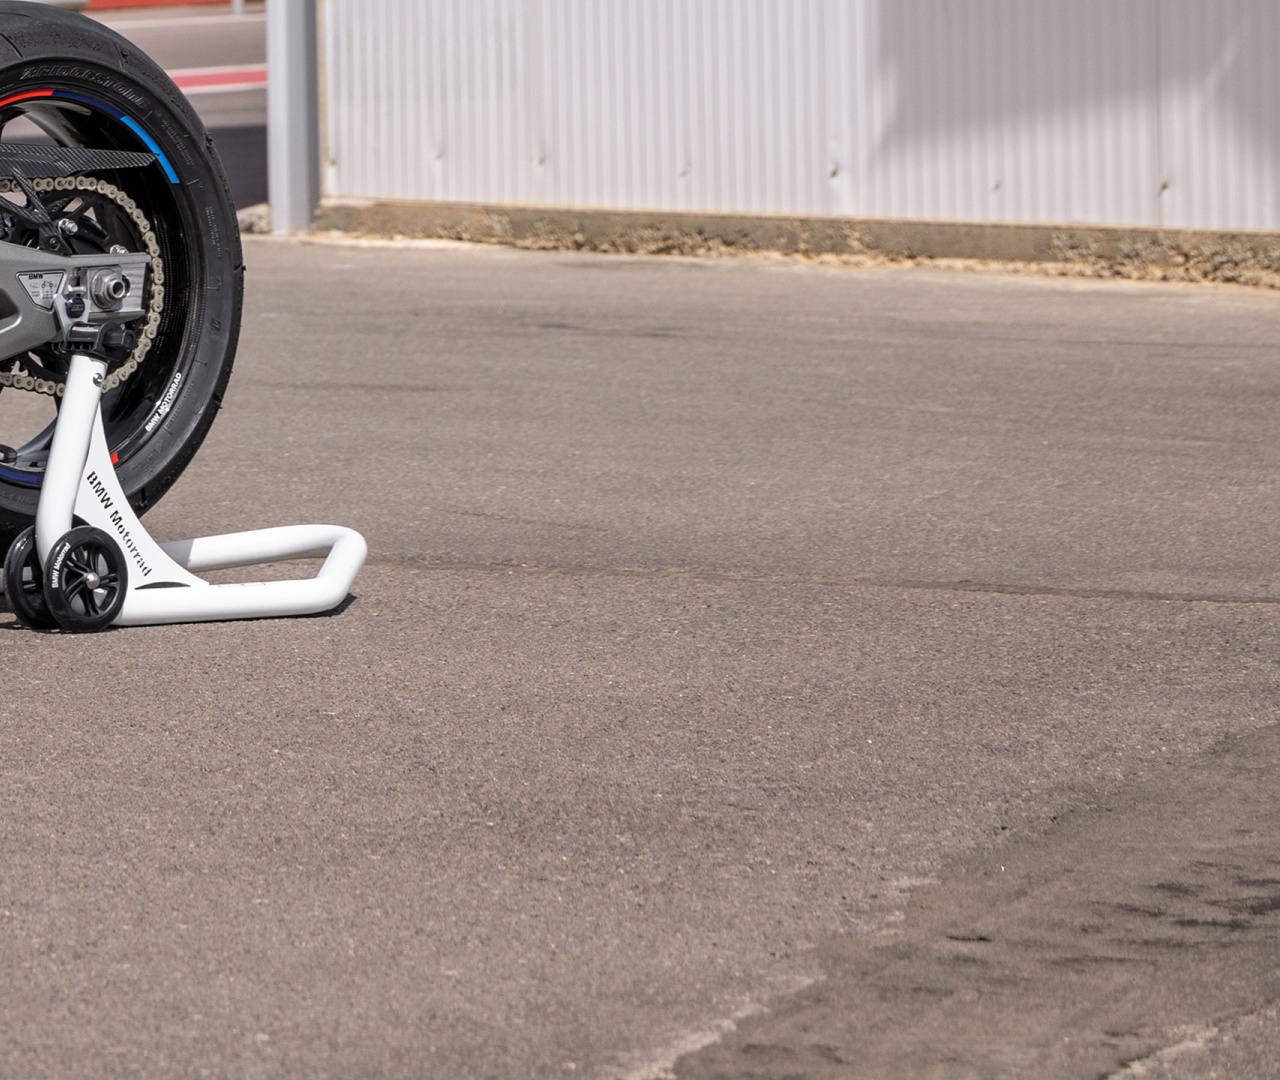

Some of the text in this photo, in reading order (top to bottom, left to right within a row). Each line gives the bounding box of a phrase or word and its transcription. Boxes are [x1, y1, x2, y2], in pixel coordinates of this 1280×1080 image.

[144, 412, 161, 432] BMW
[157, 372, 182, 415] MOTORRAD
[86, 470, 114, 510] BMW
[109, 509, 153, 577] Motorrad
[51, 541, 72, 589] BMW Motorrad
